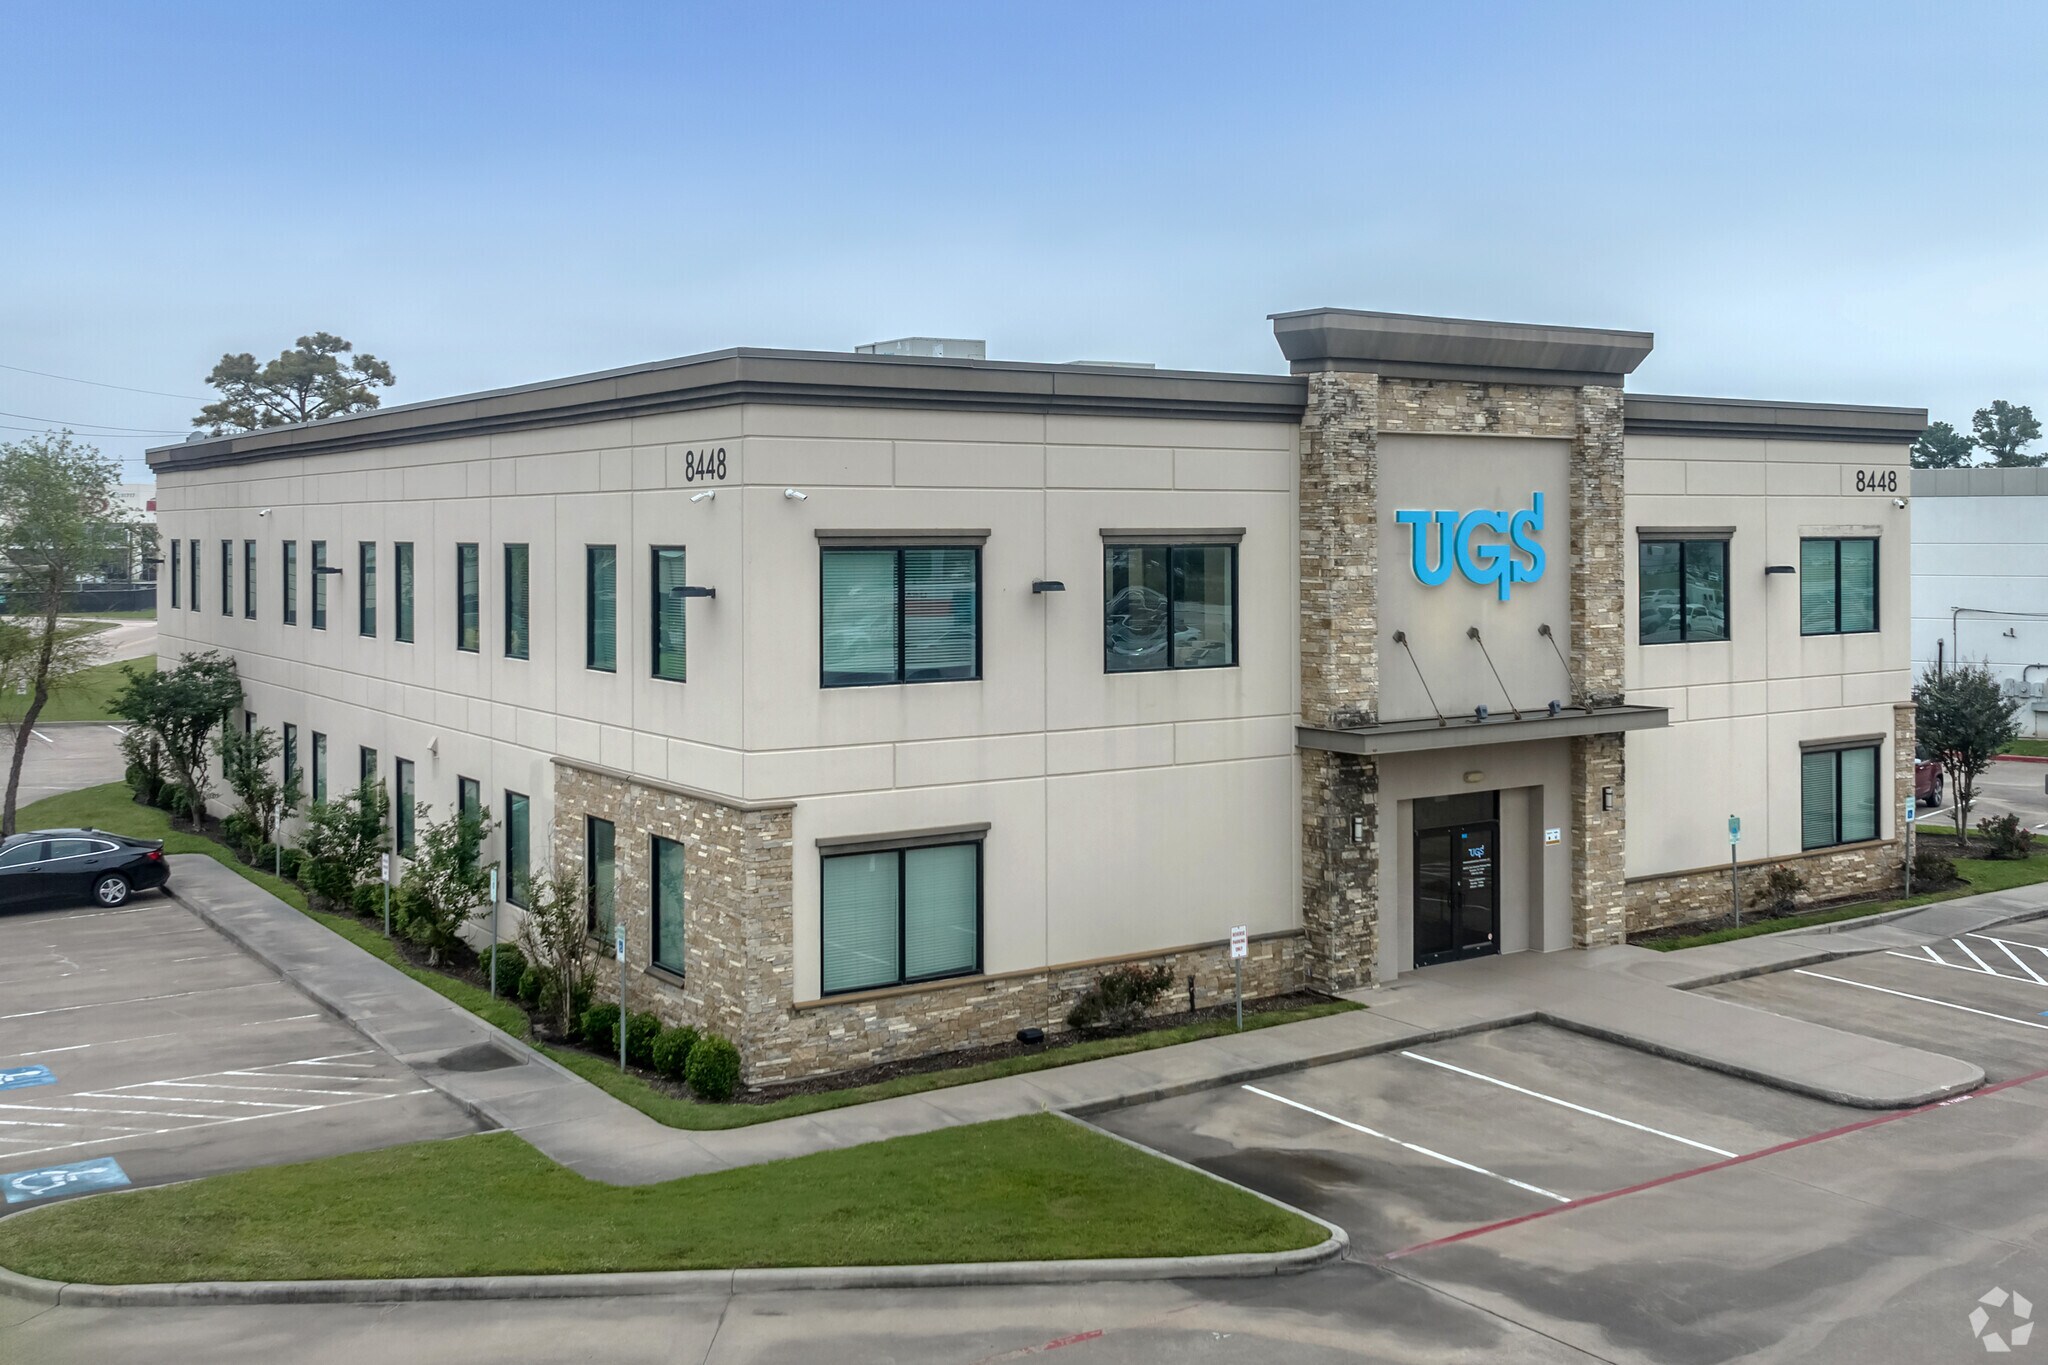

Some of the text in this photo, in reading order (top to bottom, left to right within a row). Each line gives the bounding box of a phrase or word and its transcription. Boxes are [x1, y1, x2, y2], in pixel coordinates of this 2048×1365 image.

[685, 447, 727, 482] 8448
[1856, 469, 1898, 493] 8448
[1394, 491, 1546, 601] UGS
